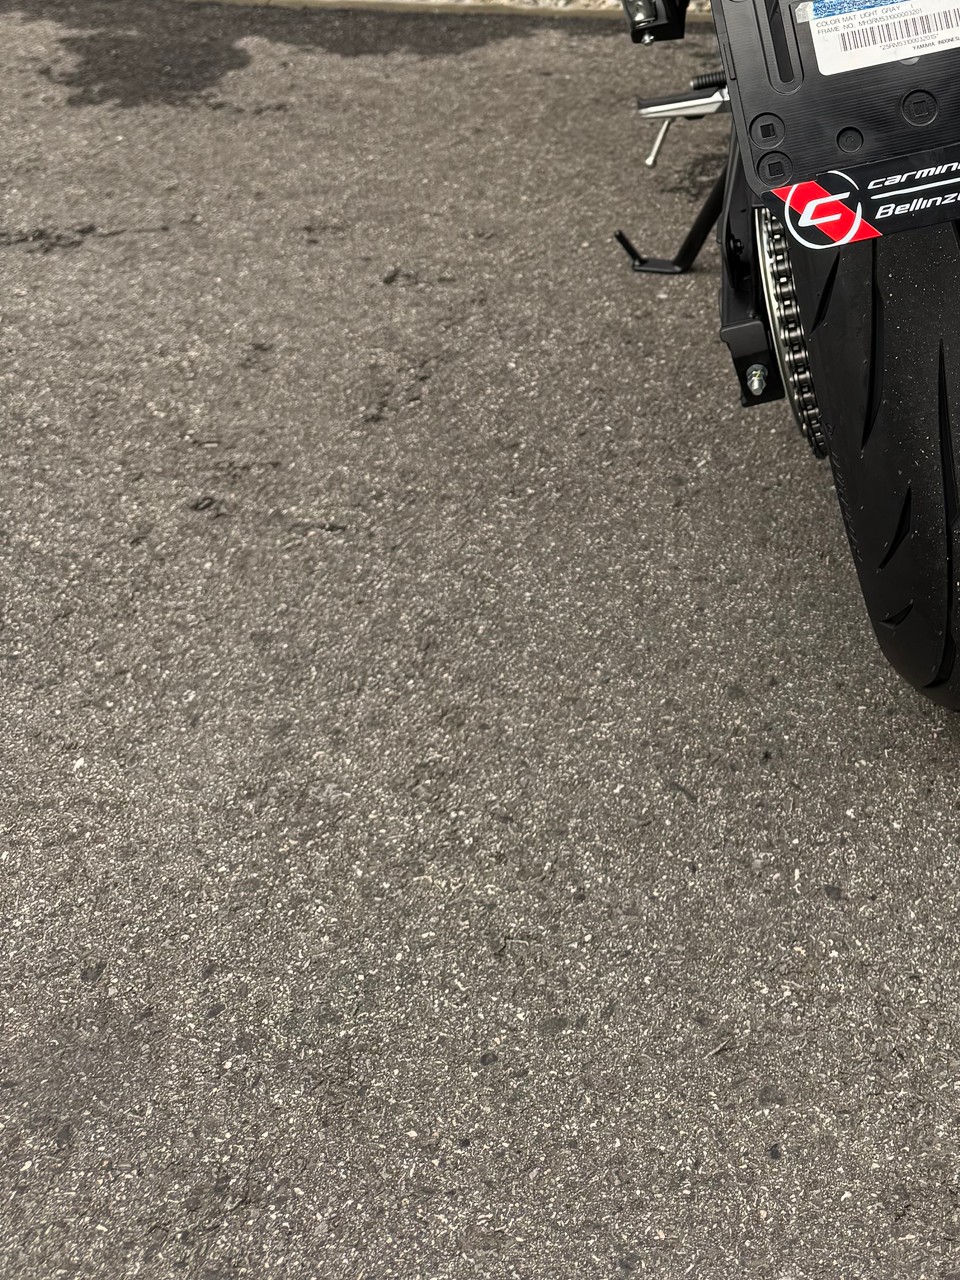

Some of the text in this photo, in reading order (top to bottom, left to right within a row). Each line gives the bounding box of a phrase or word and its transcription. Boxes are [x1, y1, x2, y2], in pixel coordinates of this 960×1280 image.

[816, 18, 841, 28] COLOR
[842, 14, 857, 23] MAT
[860, 10, 879, 19] LIGHT
[882, 5, 901, 15] GRAY
[817, 25, 841, 35] FRAME
[912, 40, 936, 51] YAMAHA
